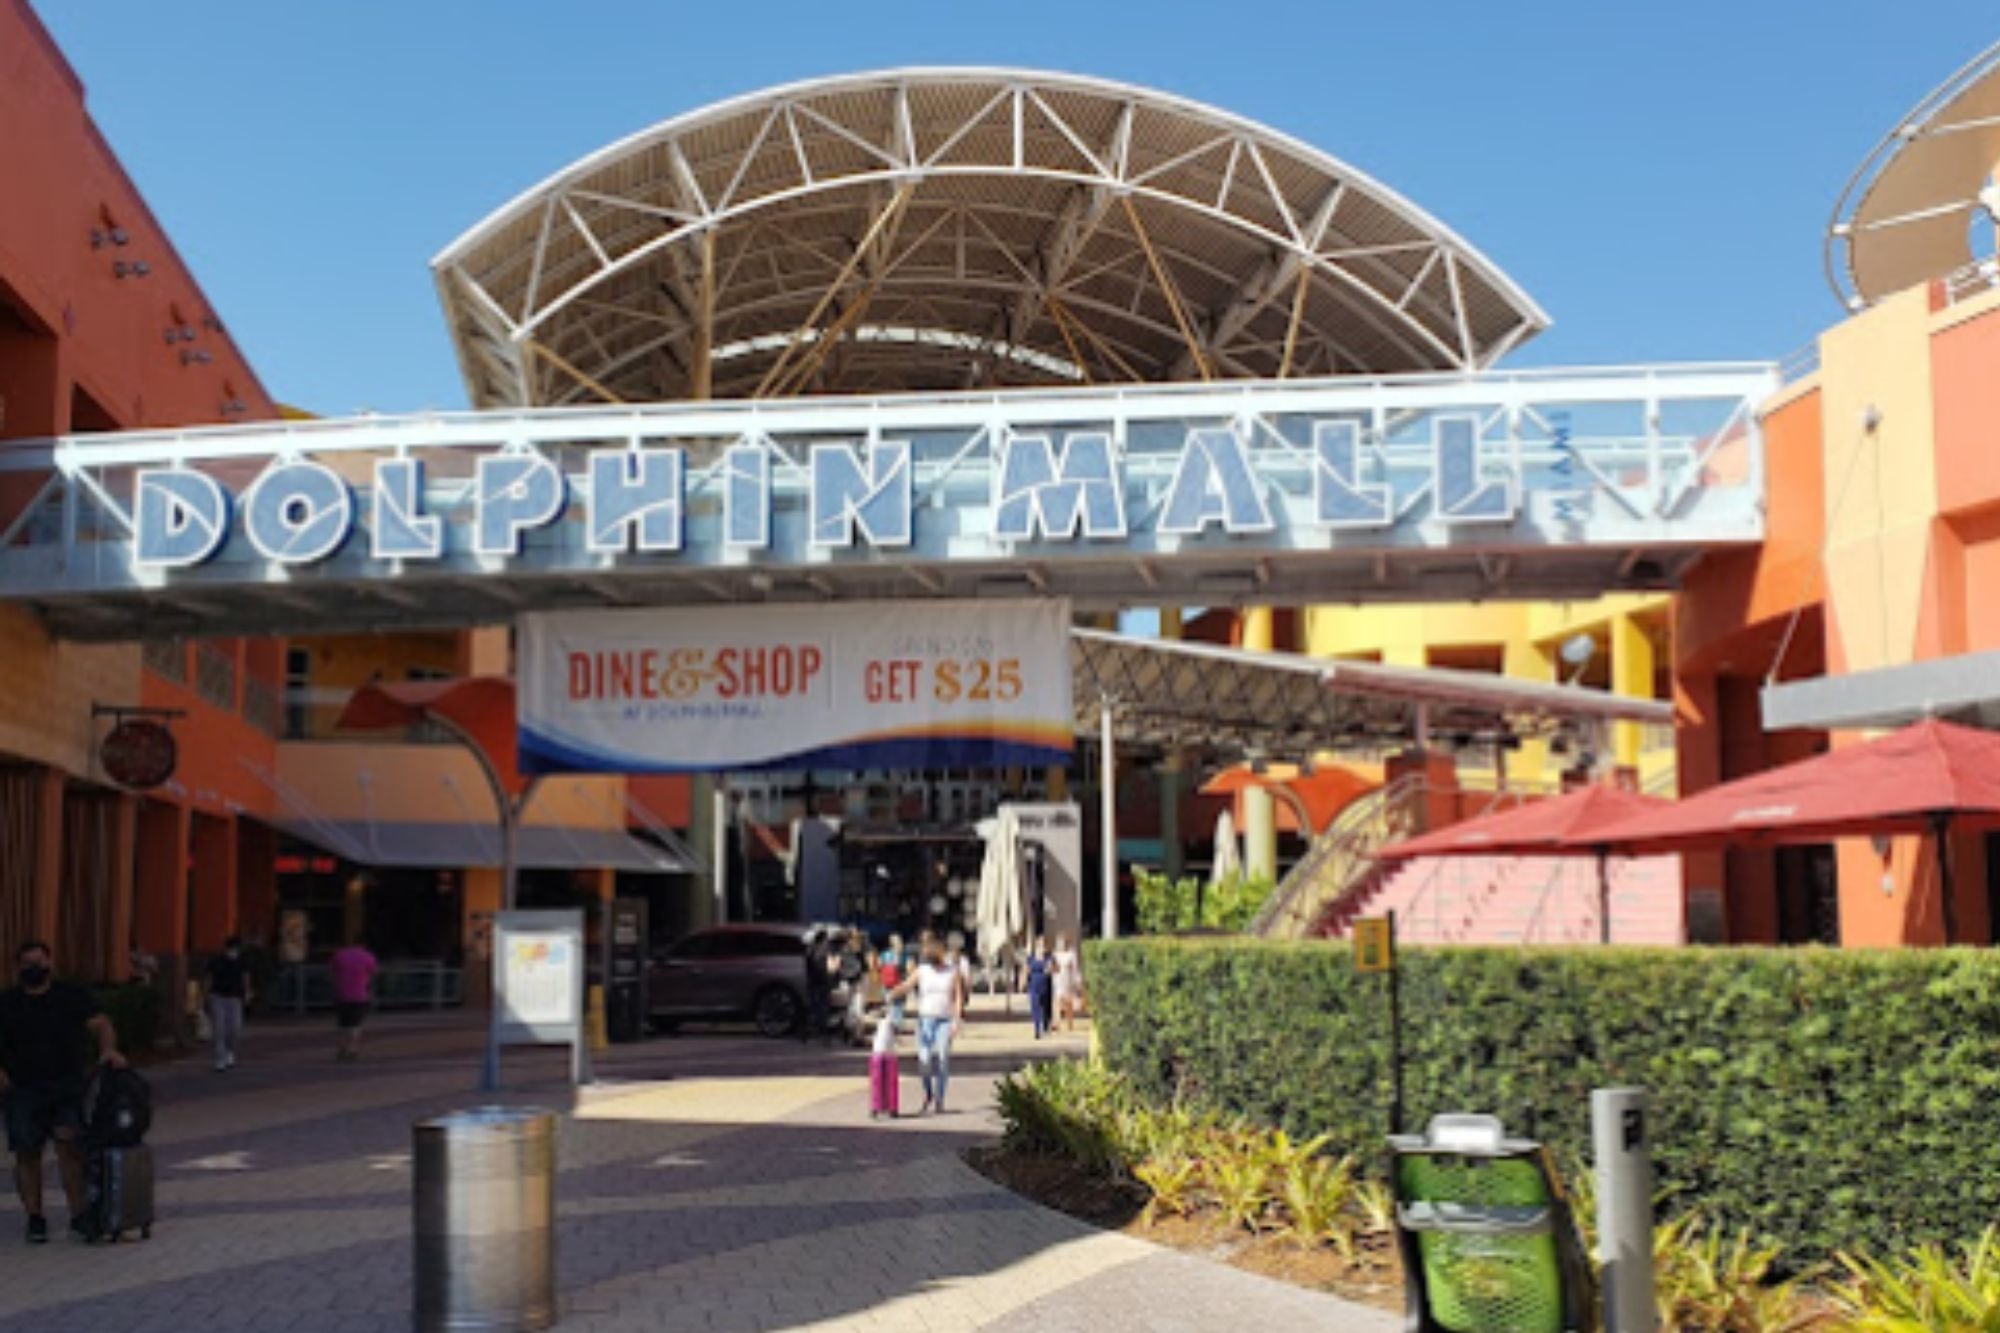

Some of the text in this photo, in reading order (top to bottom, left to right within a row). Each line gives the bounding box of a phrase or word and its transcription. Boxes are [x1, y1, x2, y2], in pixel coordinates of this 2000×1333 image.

[134, 412, 1519, 567] DOLPHIN MALL
[864, 658, 1024, 705] GET $25
